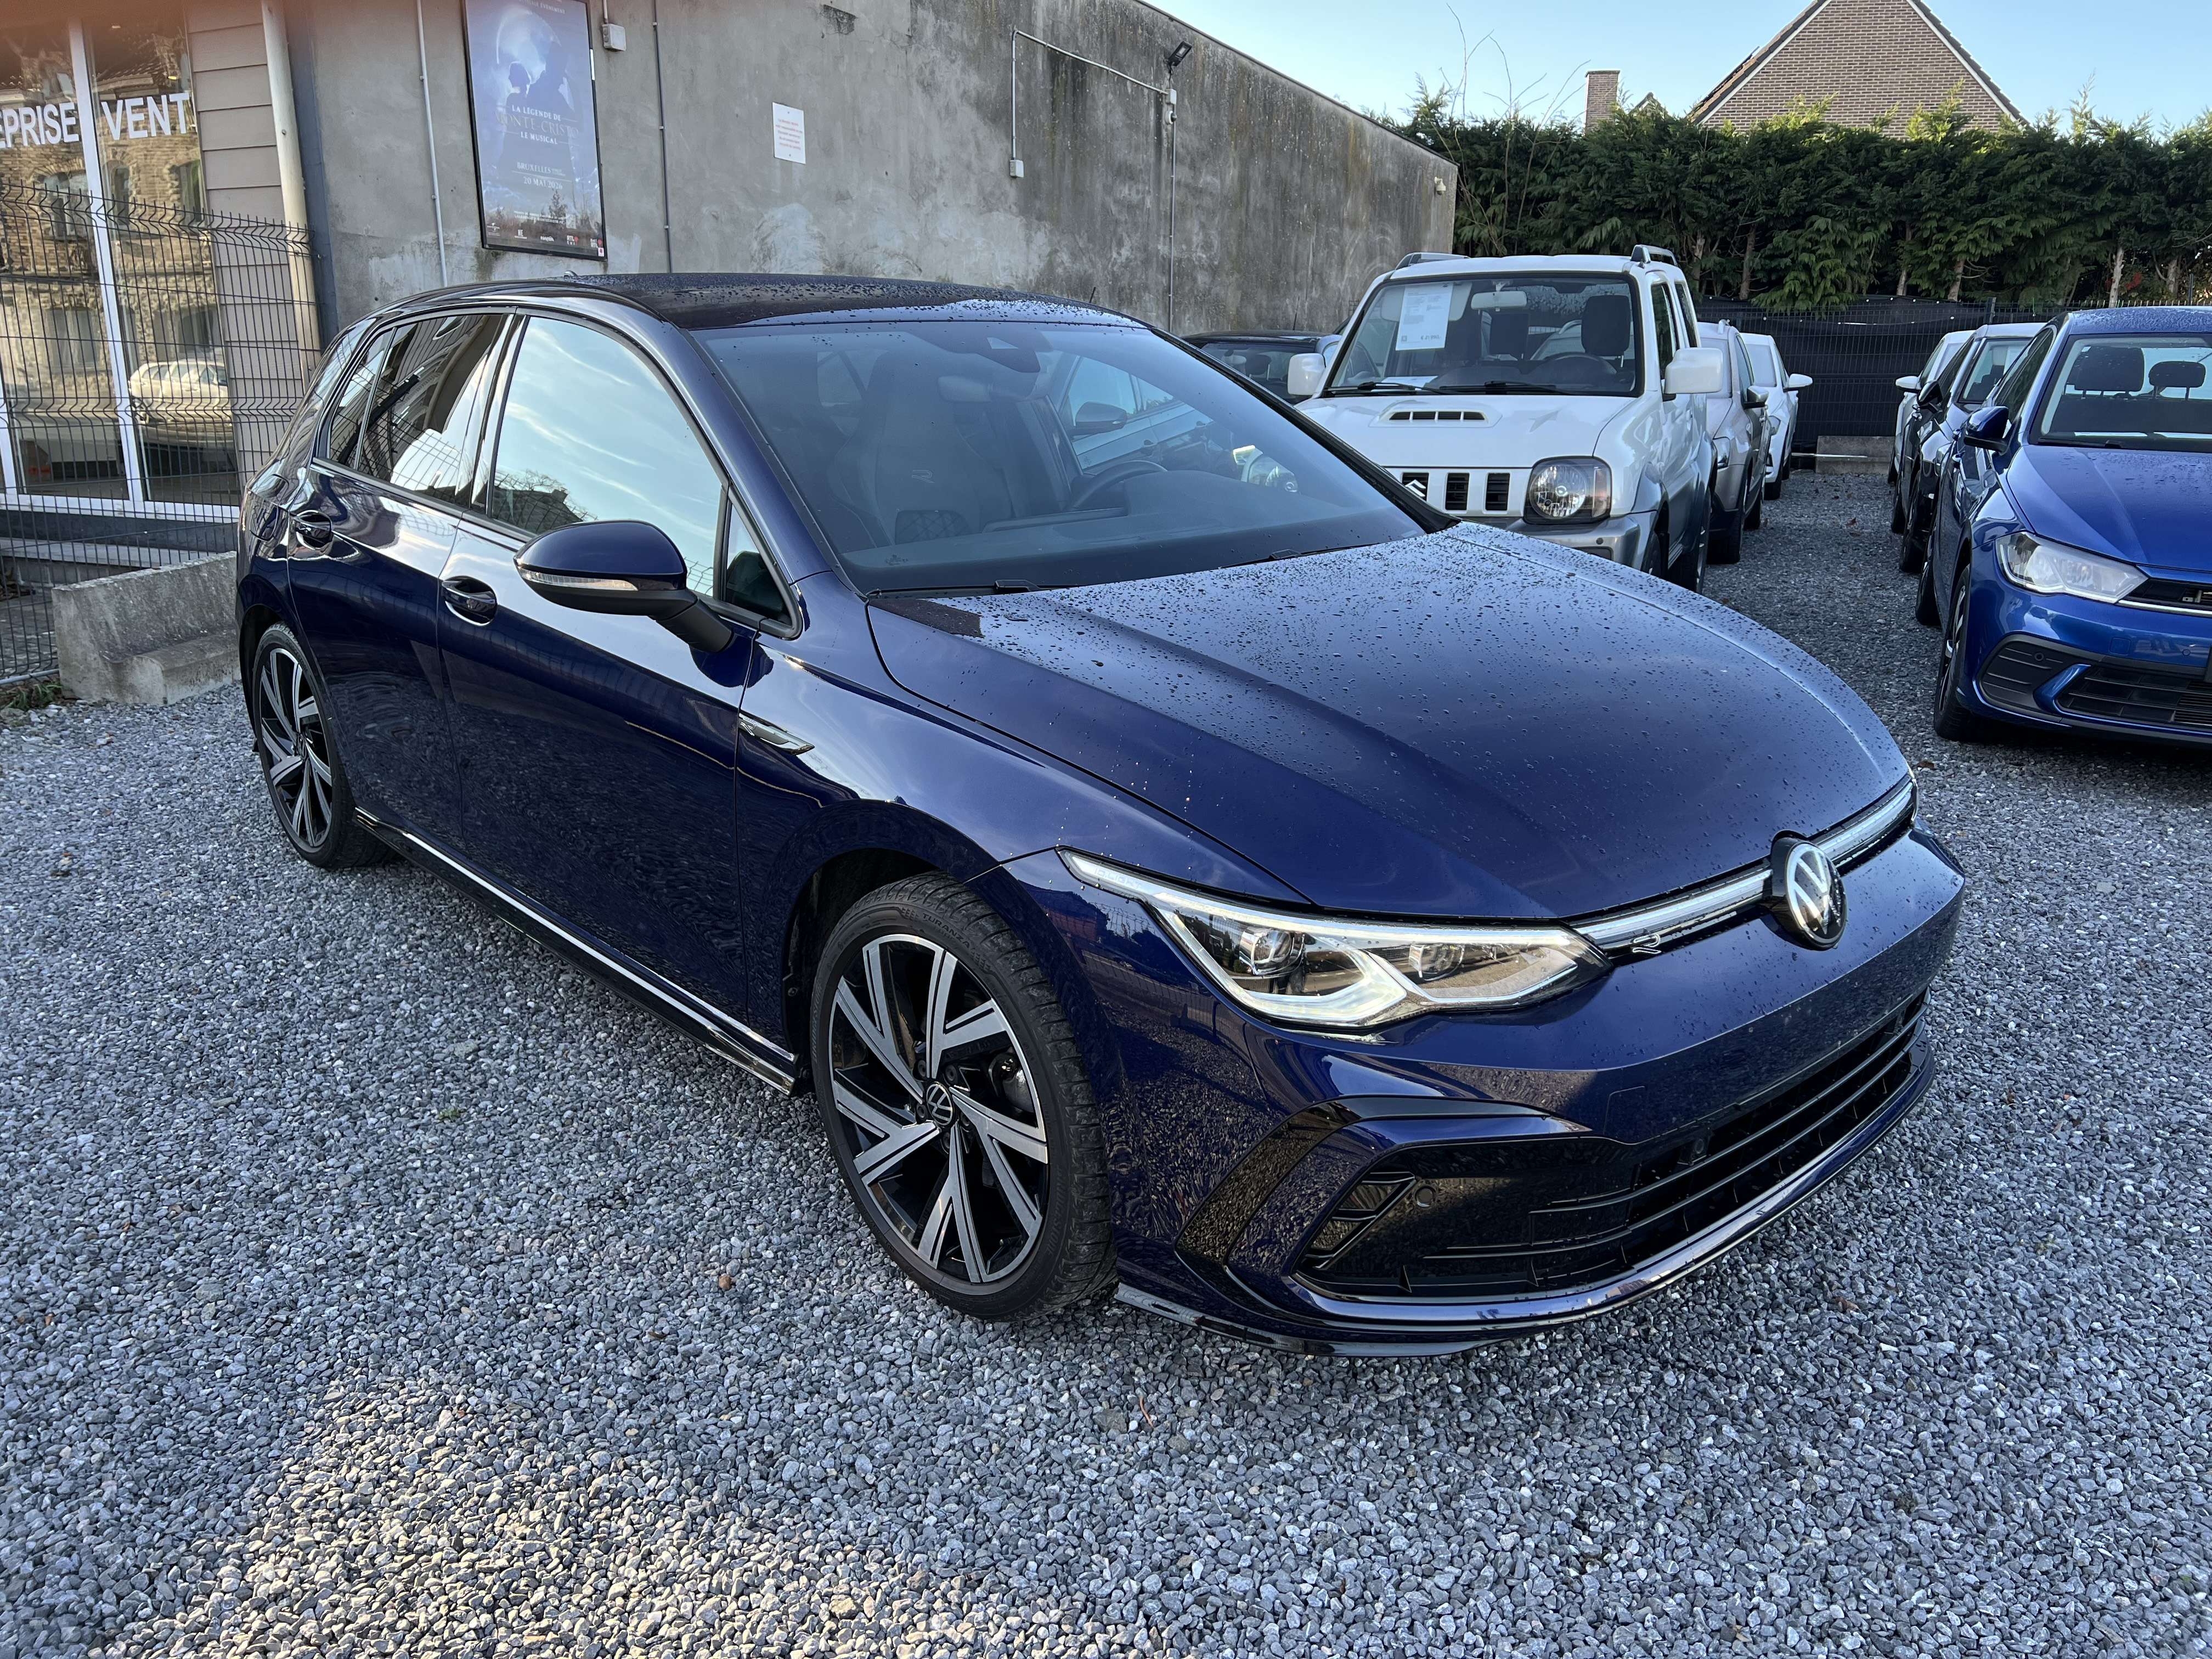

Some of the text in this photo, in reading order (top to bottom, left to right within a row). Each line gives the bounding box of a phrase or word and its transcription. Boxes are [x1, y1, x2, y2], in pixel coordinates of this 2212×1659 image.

[101, 93, 189, 140] VENT
[511, 105, 562, 122] LA LÉGENDE DE
[521, 131, 558, 145] LE MUSICAL
[517, 162, 552, 174] BRUXELLES
[523, 176, 532, 185] 20
[922, 912, 970, 949] TURANZA
